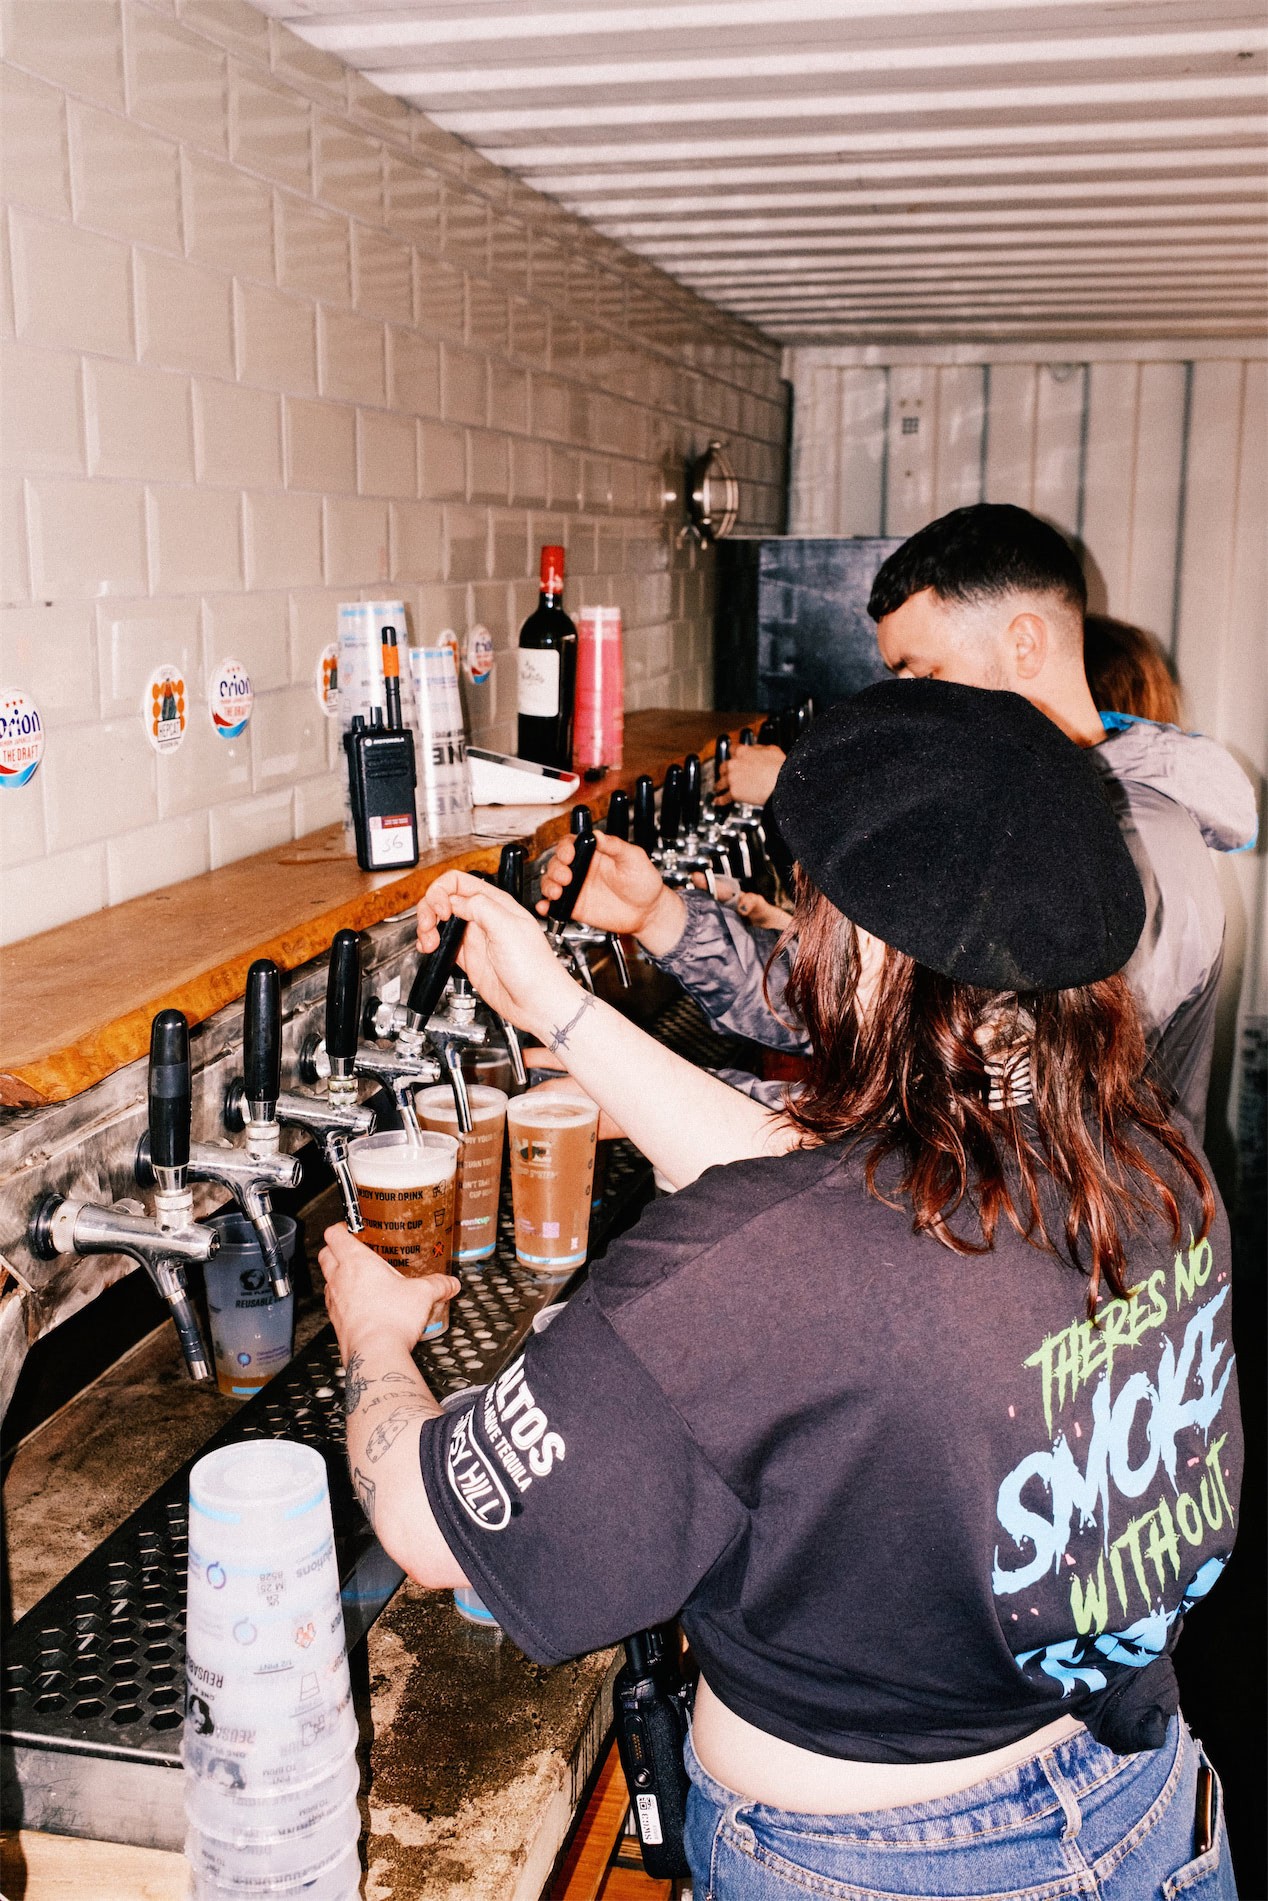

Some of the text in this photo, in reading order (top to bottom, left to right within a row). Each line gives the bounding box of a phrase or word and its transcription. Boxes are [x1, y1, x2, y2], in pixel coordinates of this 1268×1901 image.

[3, 745, 38, 762] THE DRAFT
[373, 737, 405, 745] MOTOROLA
[374, 1191, 396, 1201] YOUR
[398, 1190, 424, 1201] DRINK
[384, 1220, 405, 1230] YOUR
[407, 1220, 423, 1230] CUP
[381, 1245, 399, 1255] TAKE
[400, 1244, 421, 1254] YOUR
[1174, 1223, 1213, 1312] NO
[235, 1296, 273, 1309] REUSABLE
[496, 1353, 566, 1477] ALTOS
[993, 1283, 1237, 1597] SMOKE
[494, 1434, 533, 1493] TEQUILA
[457, 1460, 500, 1521] HILL
[1069, 1431, 1234, 1637] WITHOUT
